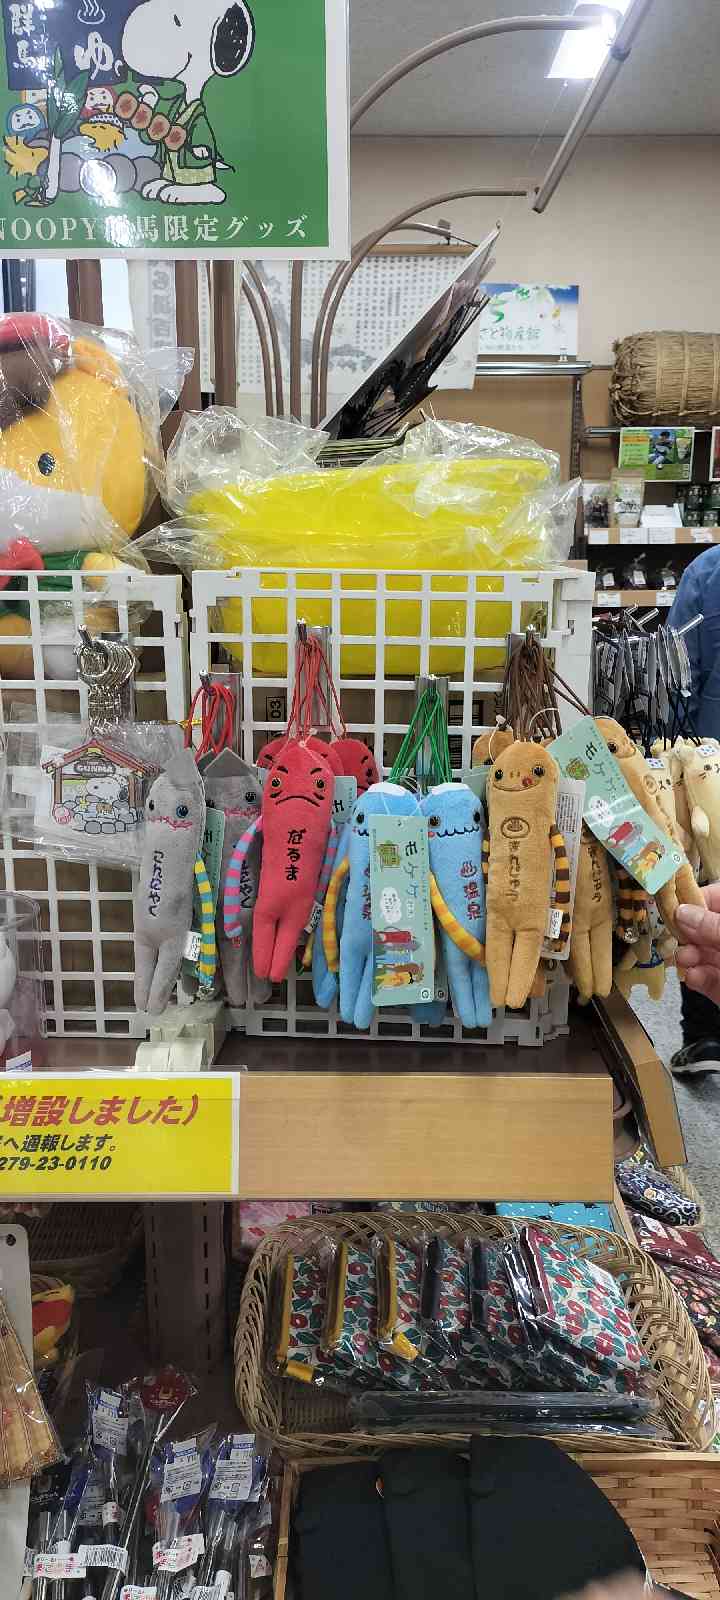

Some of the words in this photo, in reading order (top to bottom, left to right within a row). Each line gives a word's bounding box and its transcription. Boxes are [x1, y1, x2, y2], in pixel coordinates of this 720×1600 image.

[284, 828, 306, 881] だるま
[147, 850, 164, 917] こんにゃく
[463, 881, 482, 920] 温泉
